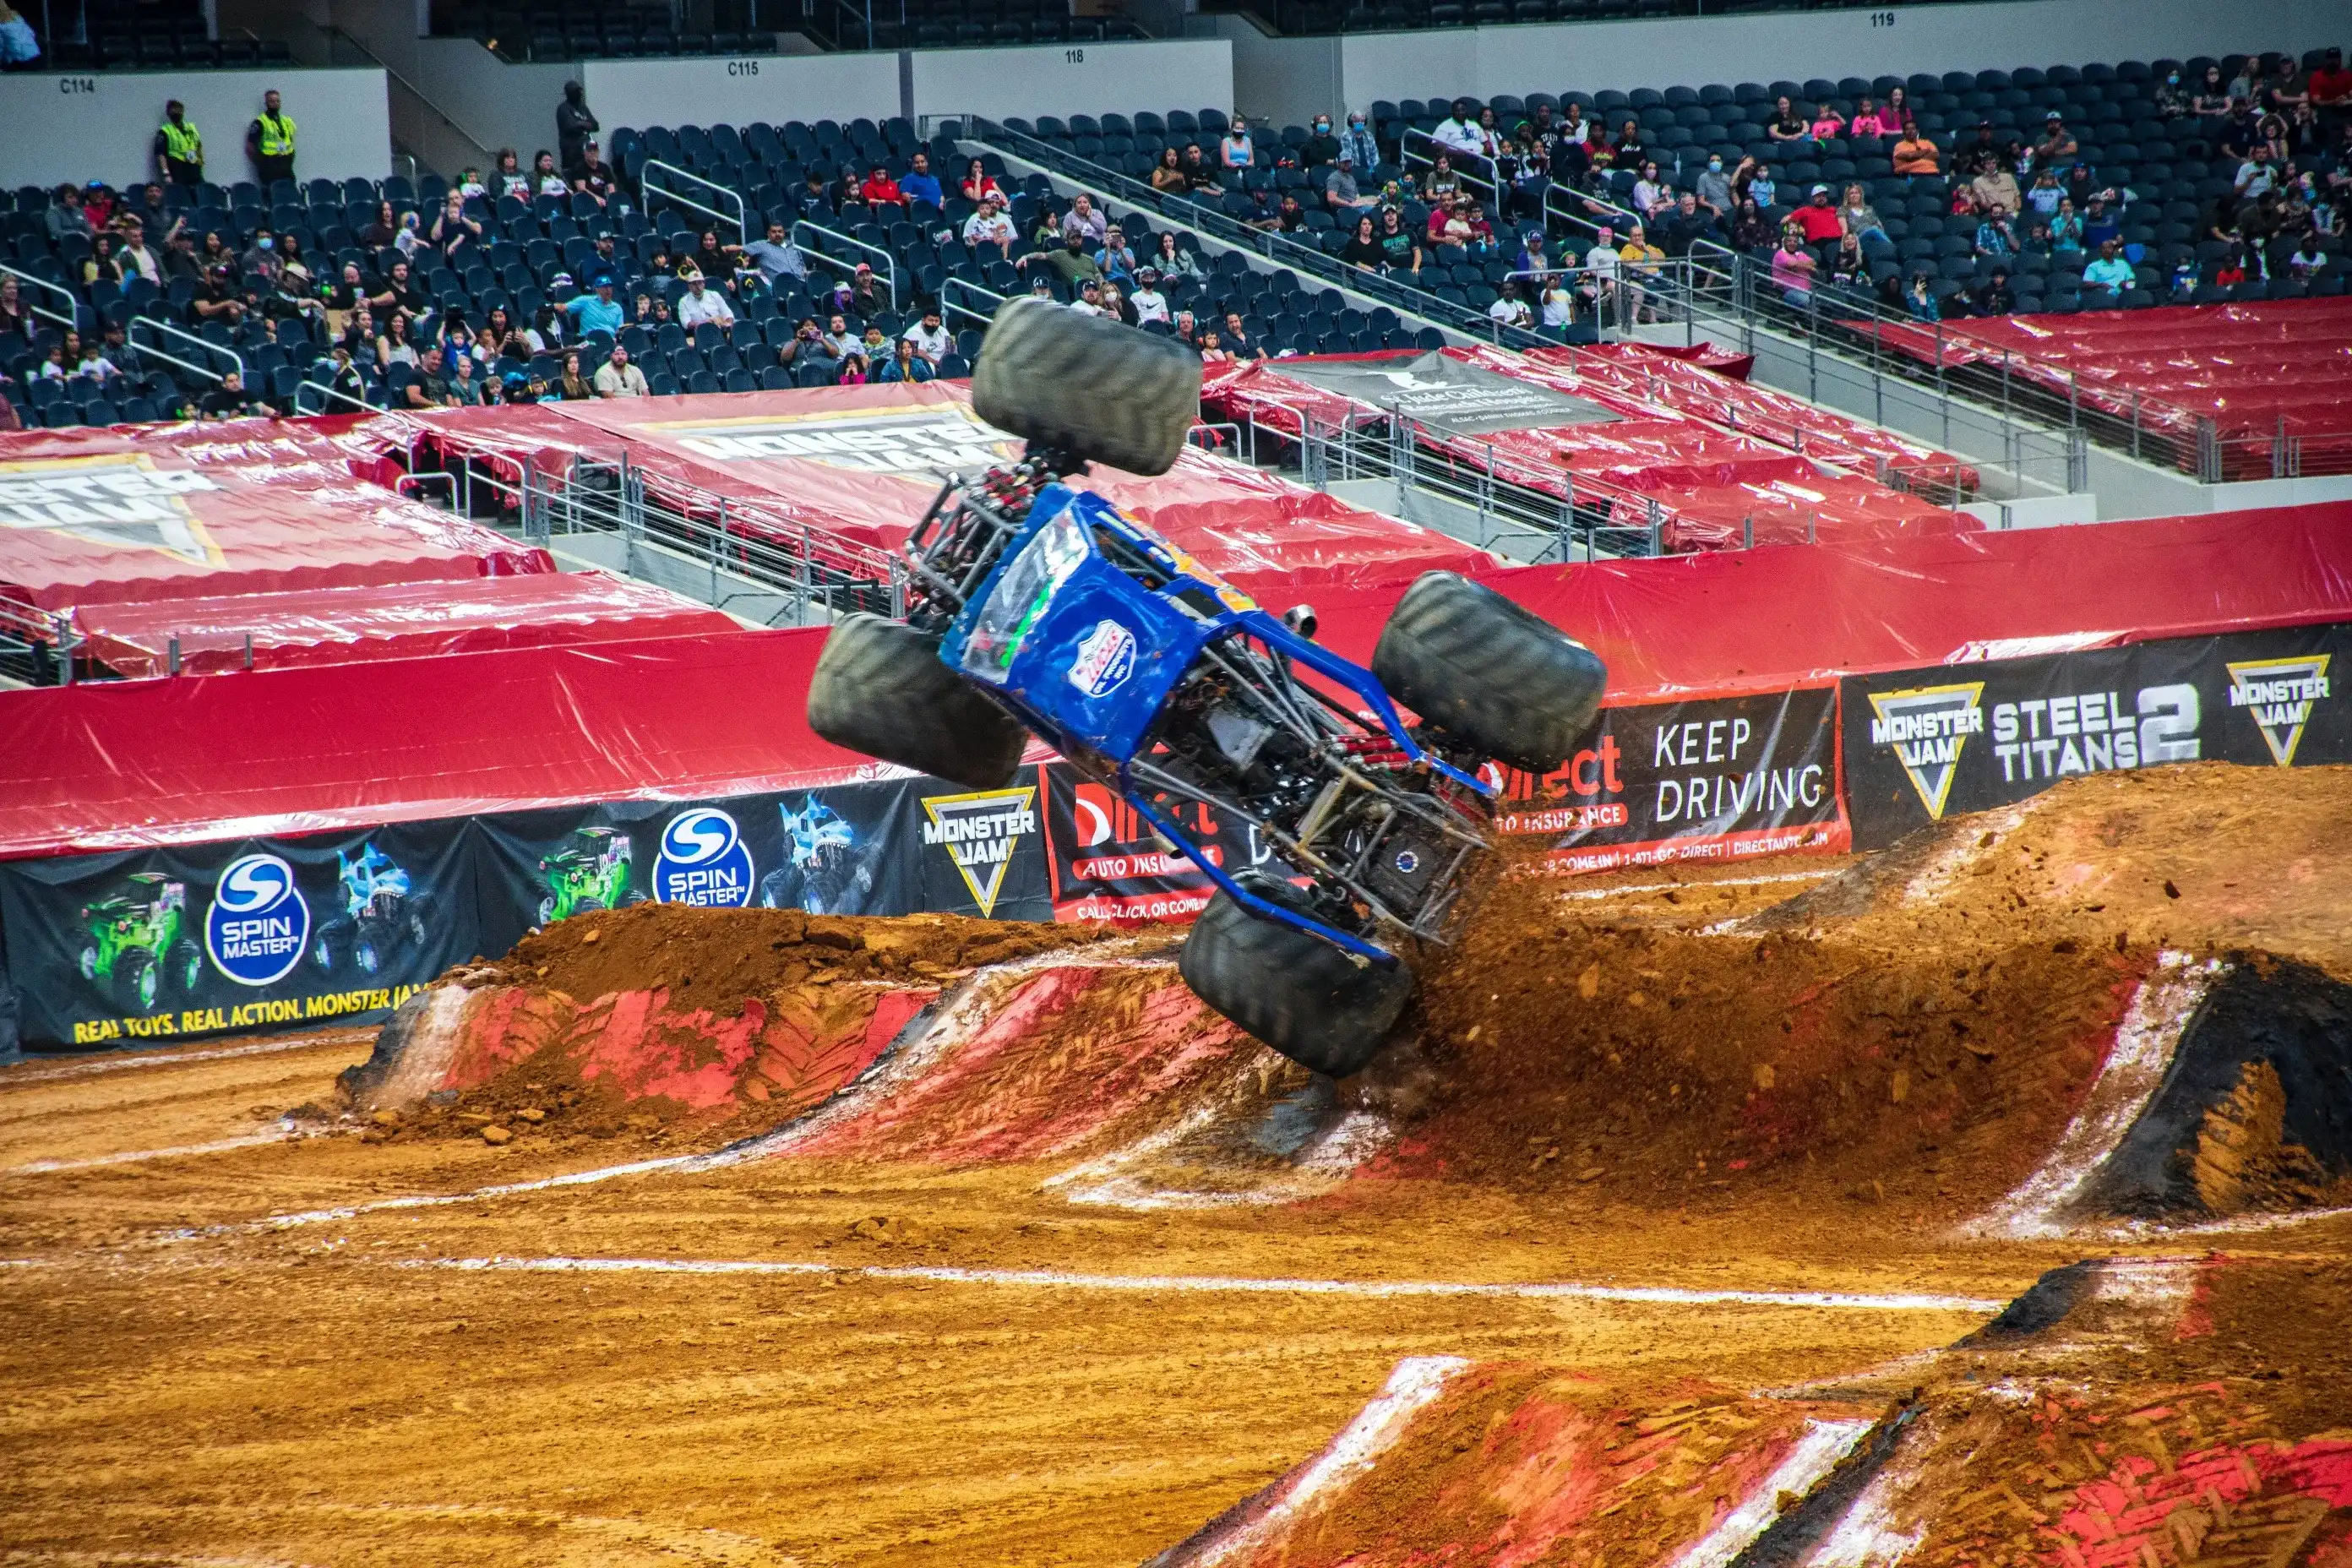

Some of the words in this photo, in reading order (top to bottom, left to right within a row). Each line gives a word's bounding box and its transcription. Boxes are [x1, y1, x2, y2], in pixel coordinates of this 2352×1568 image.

[1870, 12, 1895, 28] 119
[727, 62, 759, 77] C115
[1064, 49, 1084, 63] 118
[60, 79, 95, 94] C114
[2228, 676, 2331, 706] MONSTER
[1870, 706, 1984, 744] MONSTER
[1992, 691, 2137, 743] STEEL
[2137, 683, 2202, 765] 2
[2259, 701, 2304, 727] JAM
[1654, 718, 1751, 768] KEEP
[1904, 737, 1957, 767] JAM
[1994, 731, 2139, 782] TITANS
[1656, 764, 1823, 822] DRIVING
[923, 809, 1037, 845] MONSTER
[958, 838, 1007, 866] JAM
[668, 867, 737, 893] SPIN
[1083, 858, 1127, 877] AUTO
[1151, 902, 1168, 917] OR
[1168, 898, 1201, 915] COME
[221, 916, 291, 943] SPIN
[74, 1019, 122, 1044] REAL
[122, 1013, 180, 1037] TOYS.
[181, 1007, 228, 1032] REAL
[230, 998, 303, 1028] ACTION.
[306, 988, 391, 1018] MONSTER
